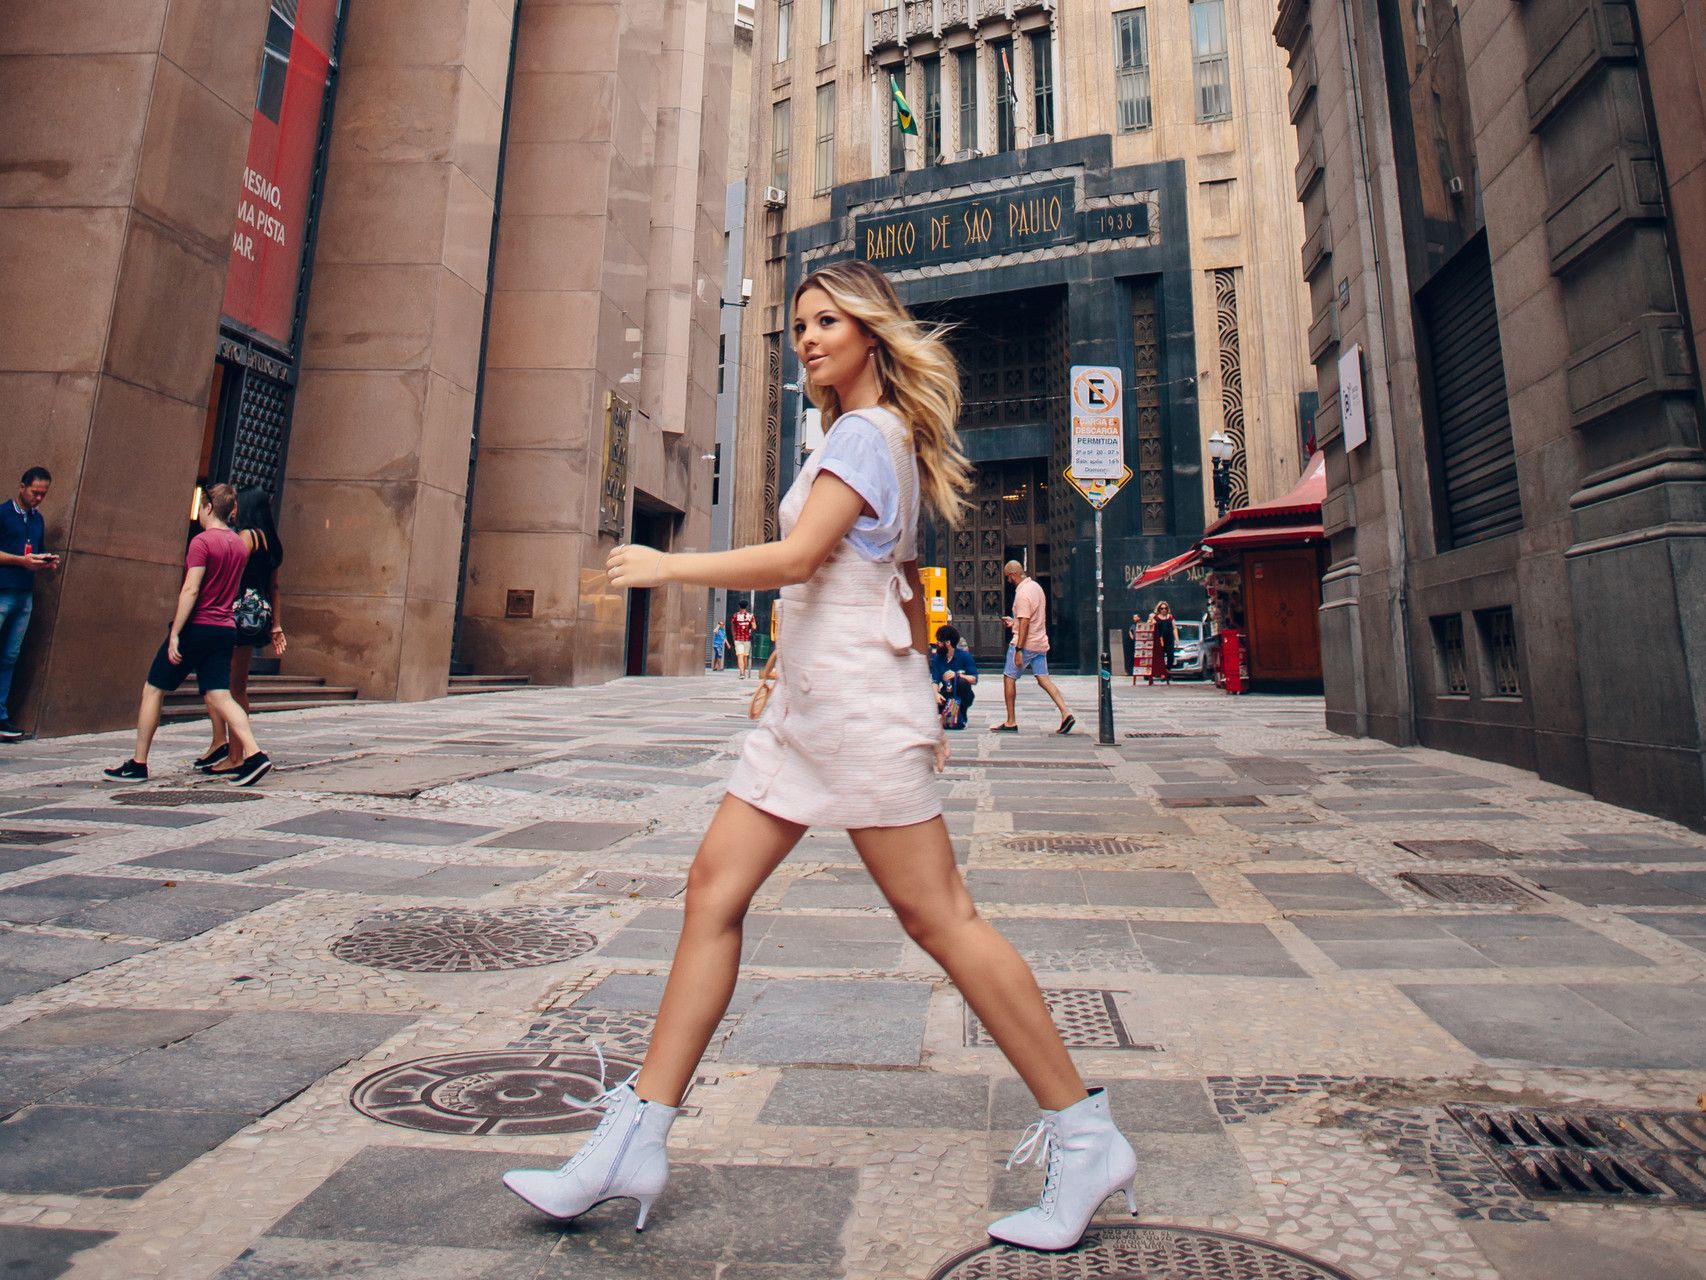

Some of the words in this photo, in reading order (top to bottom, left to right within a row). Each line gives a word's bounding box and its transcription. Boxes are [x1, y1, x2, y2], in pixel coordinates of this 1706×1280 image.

[256, 209, 285, 246] PISTA
[866, 221, 916, 261] BANCO
[931, 214, 951, 252] DE
[964, 202, 992, 245] SÃO
[1008, 195, 1061, 238] PAULO
[1100, 212, 1133, 233] 1938
[1089, 378, 1105, 405] E
[1075, 427, 1118, 435] DESCARGA
[1077, 437, 1118, 445] PERMITIDA
